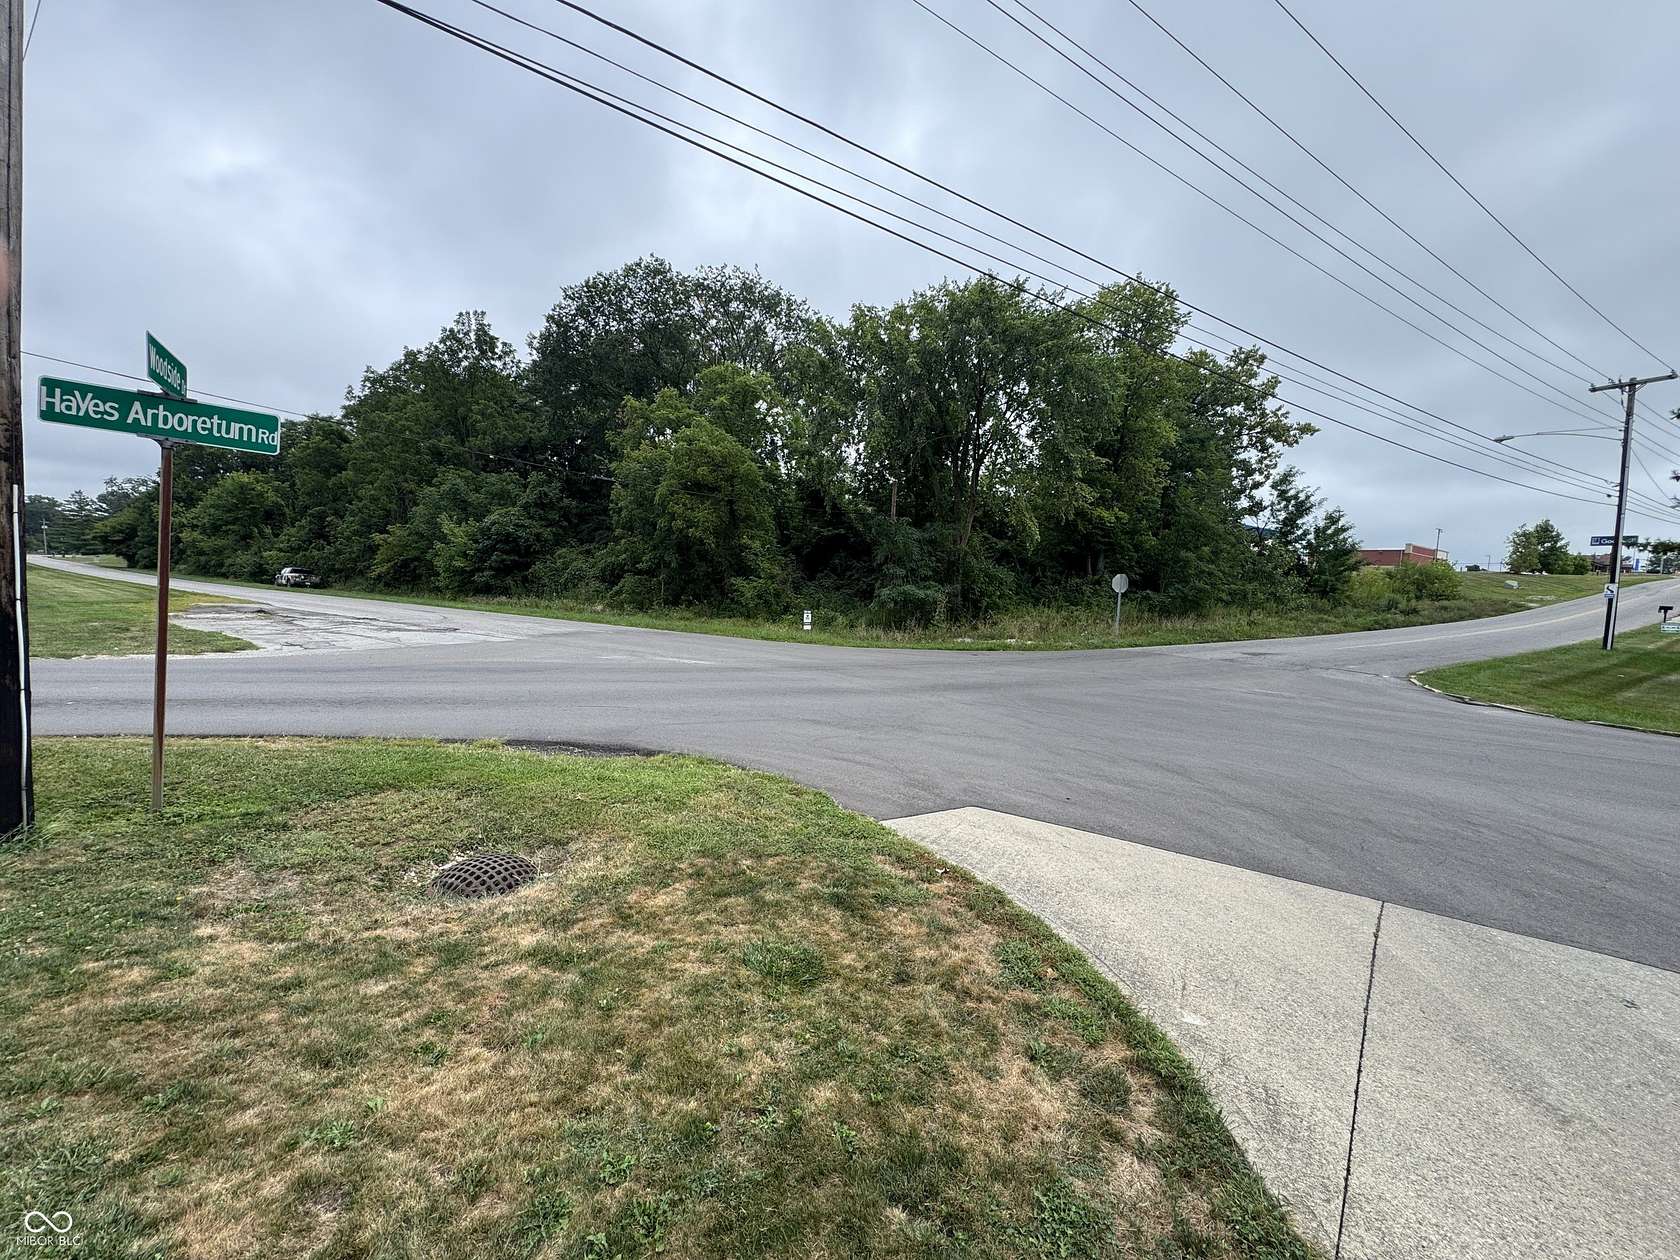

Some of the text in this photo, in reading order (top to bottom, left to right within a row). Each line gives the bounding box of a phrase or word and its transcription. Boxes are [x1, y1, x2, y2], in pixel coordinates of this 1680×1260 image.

[149, 343, 181, 390] Woodside
[126, 400, 257, 443] Arboretum
[257, 429, 278, 446] Rd
